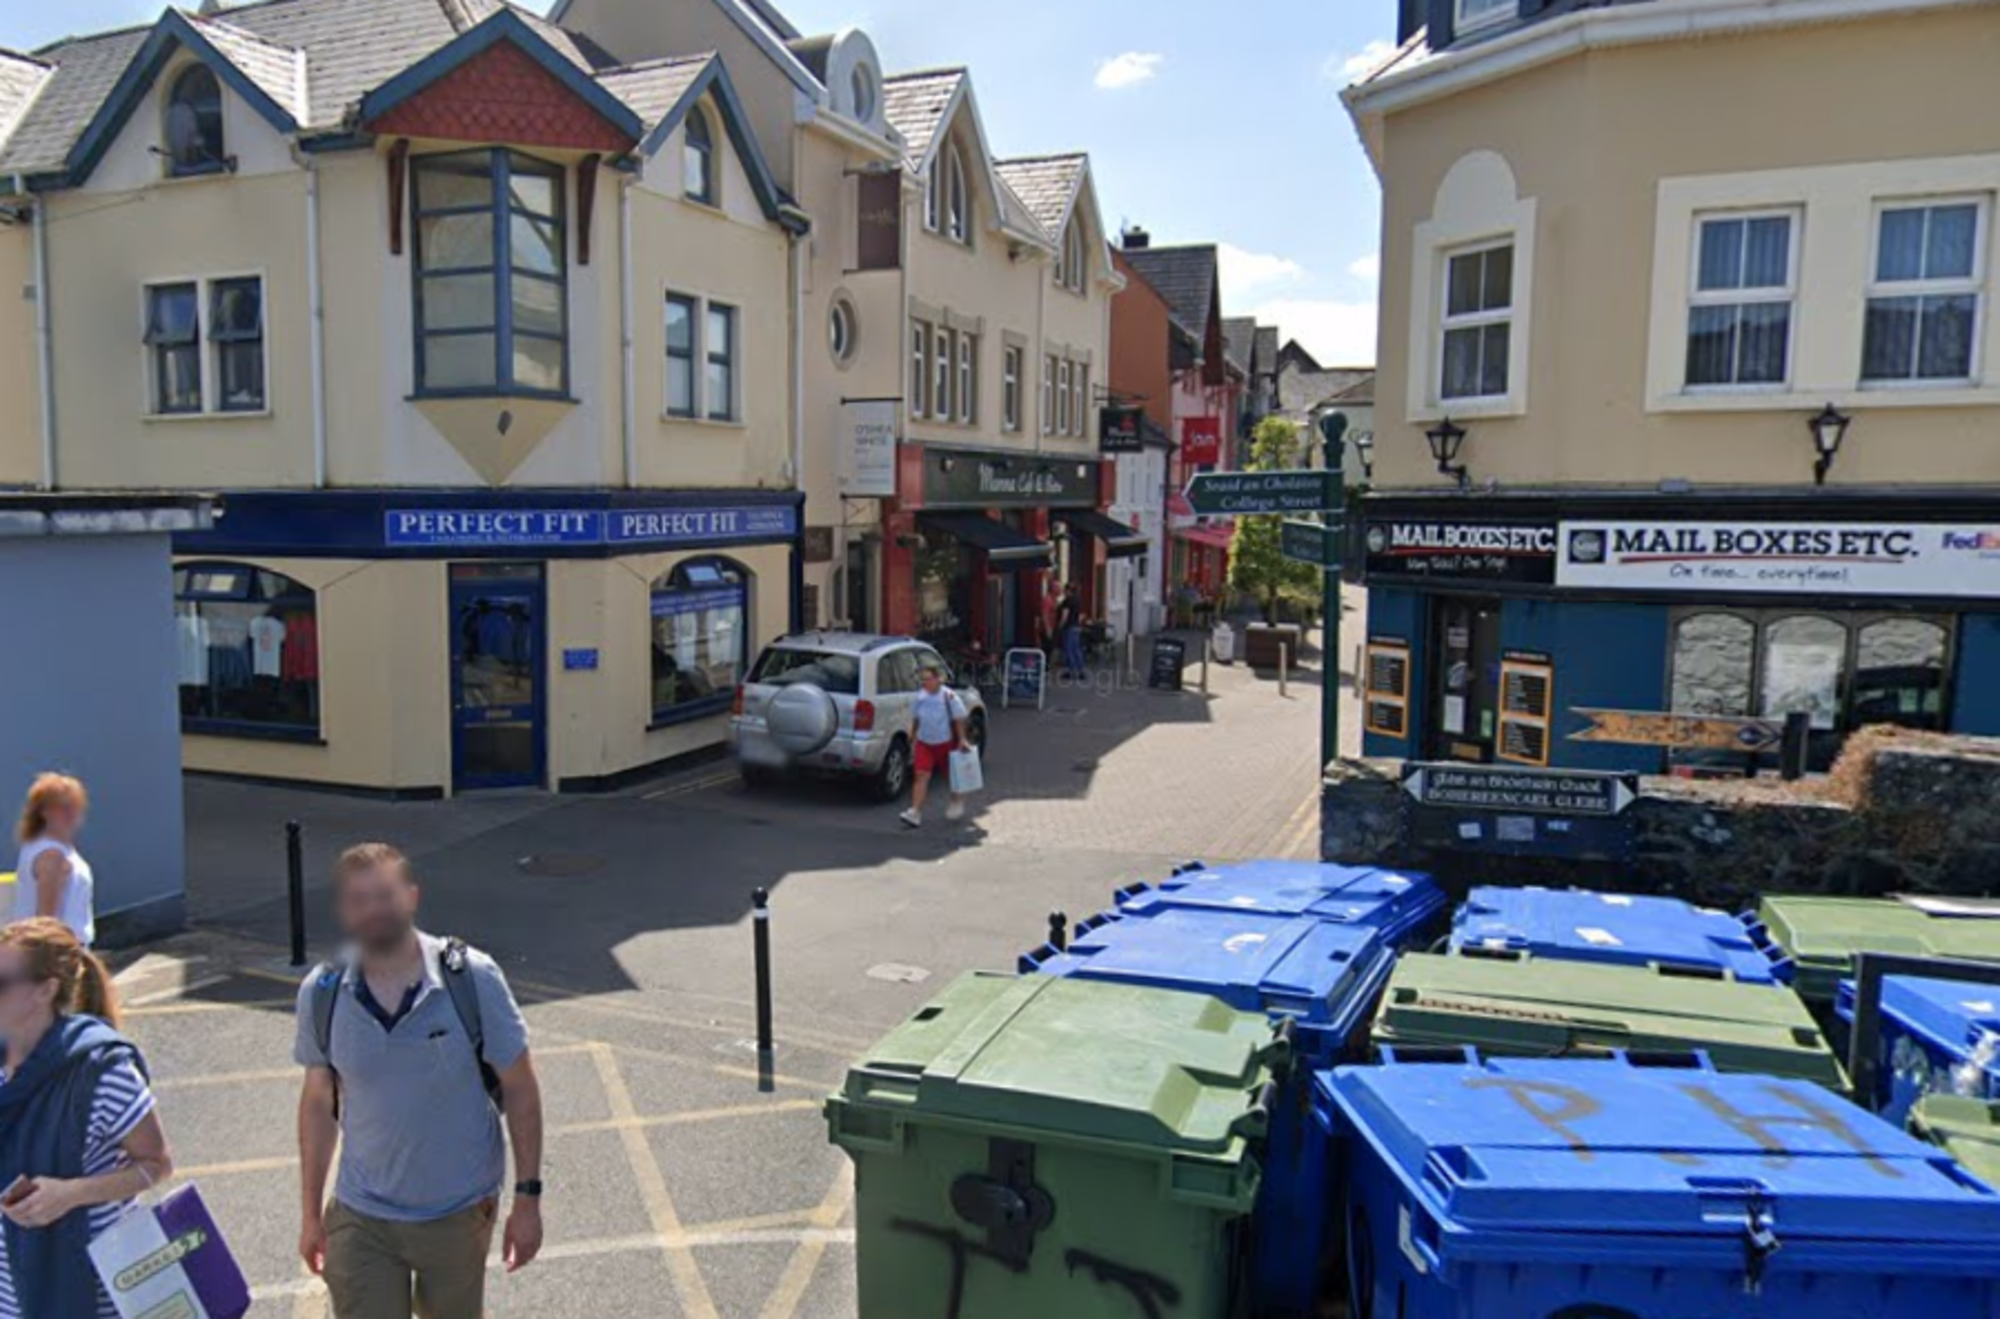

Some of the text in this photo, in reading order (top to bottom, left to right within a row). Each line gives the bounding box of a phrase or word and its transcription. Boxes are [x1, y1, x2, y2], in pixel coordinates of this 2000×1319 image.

[1219, 496, 1322, 511] College Street
[400, 514, 590, 533] PERFECT FIT
[622, 512, 706, 536] PERFECT
[711, 511, 738, 532] FIT
[1392, 525, 1441, 545] MAIL
[1445, 527, 1508, 548] BOXES
[1510, 529, 1556, 551] ETC.
[1613, 529, 1706, 552] MAIL
[1713, 529, 1832, 554] BOXES
[1838, 530, 1920, 557] ETC.
